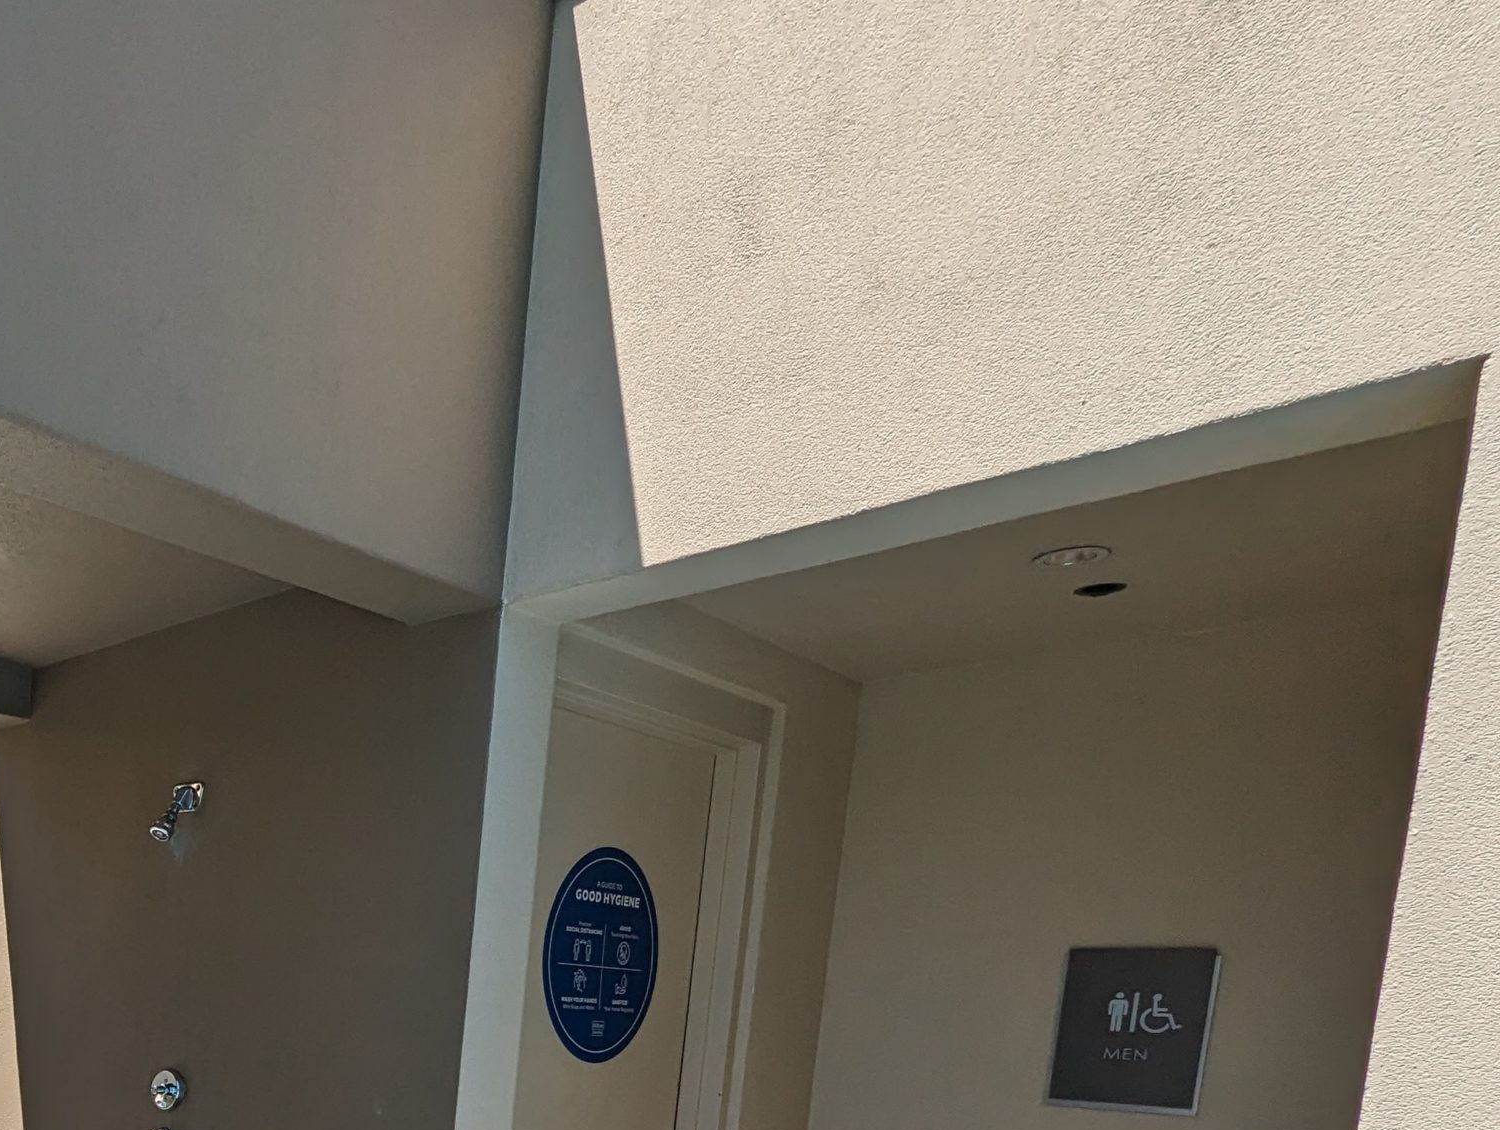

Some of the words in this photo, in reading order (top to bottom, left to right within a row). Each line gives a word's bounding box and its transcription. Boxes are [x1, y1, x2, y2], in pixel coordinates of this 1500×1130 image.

[575, 888, 602, 903] GOOD
[603, 892, 641, 909] HYGIENE
[1103, 1047, 1148, 1061] MEN
